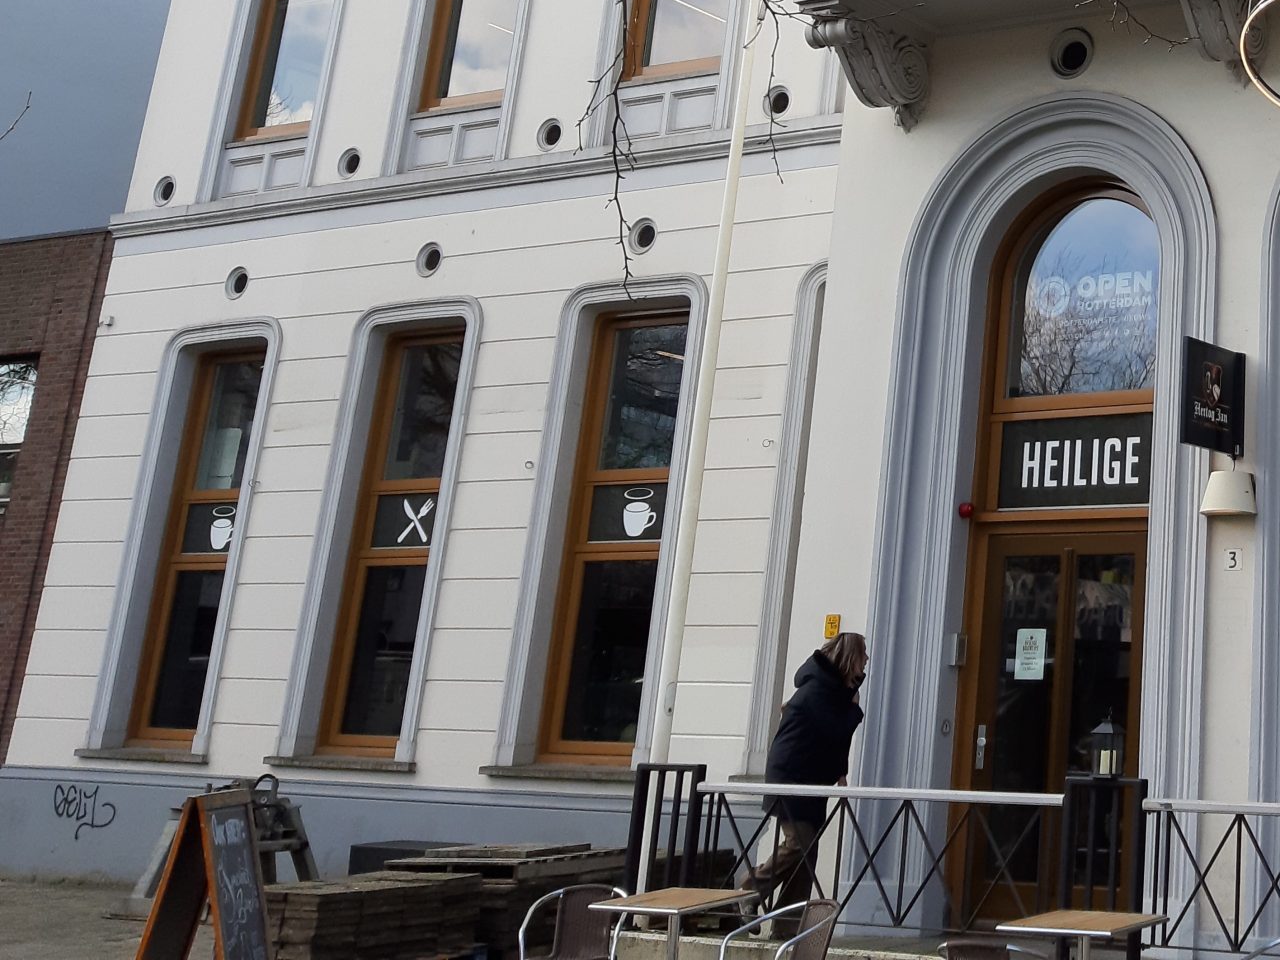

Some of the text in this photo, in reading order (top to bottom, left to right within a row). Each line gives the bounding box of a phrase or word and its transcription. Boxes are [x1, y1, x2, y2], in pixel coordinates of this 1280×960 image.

[1077, 270, 1152, 297] OPEN
[1021, 437, 1141, 488] HEILIGE
[1229, 551, 1237, 568] 3
